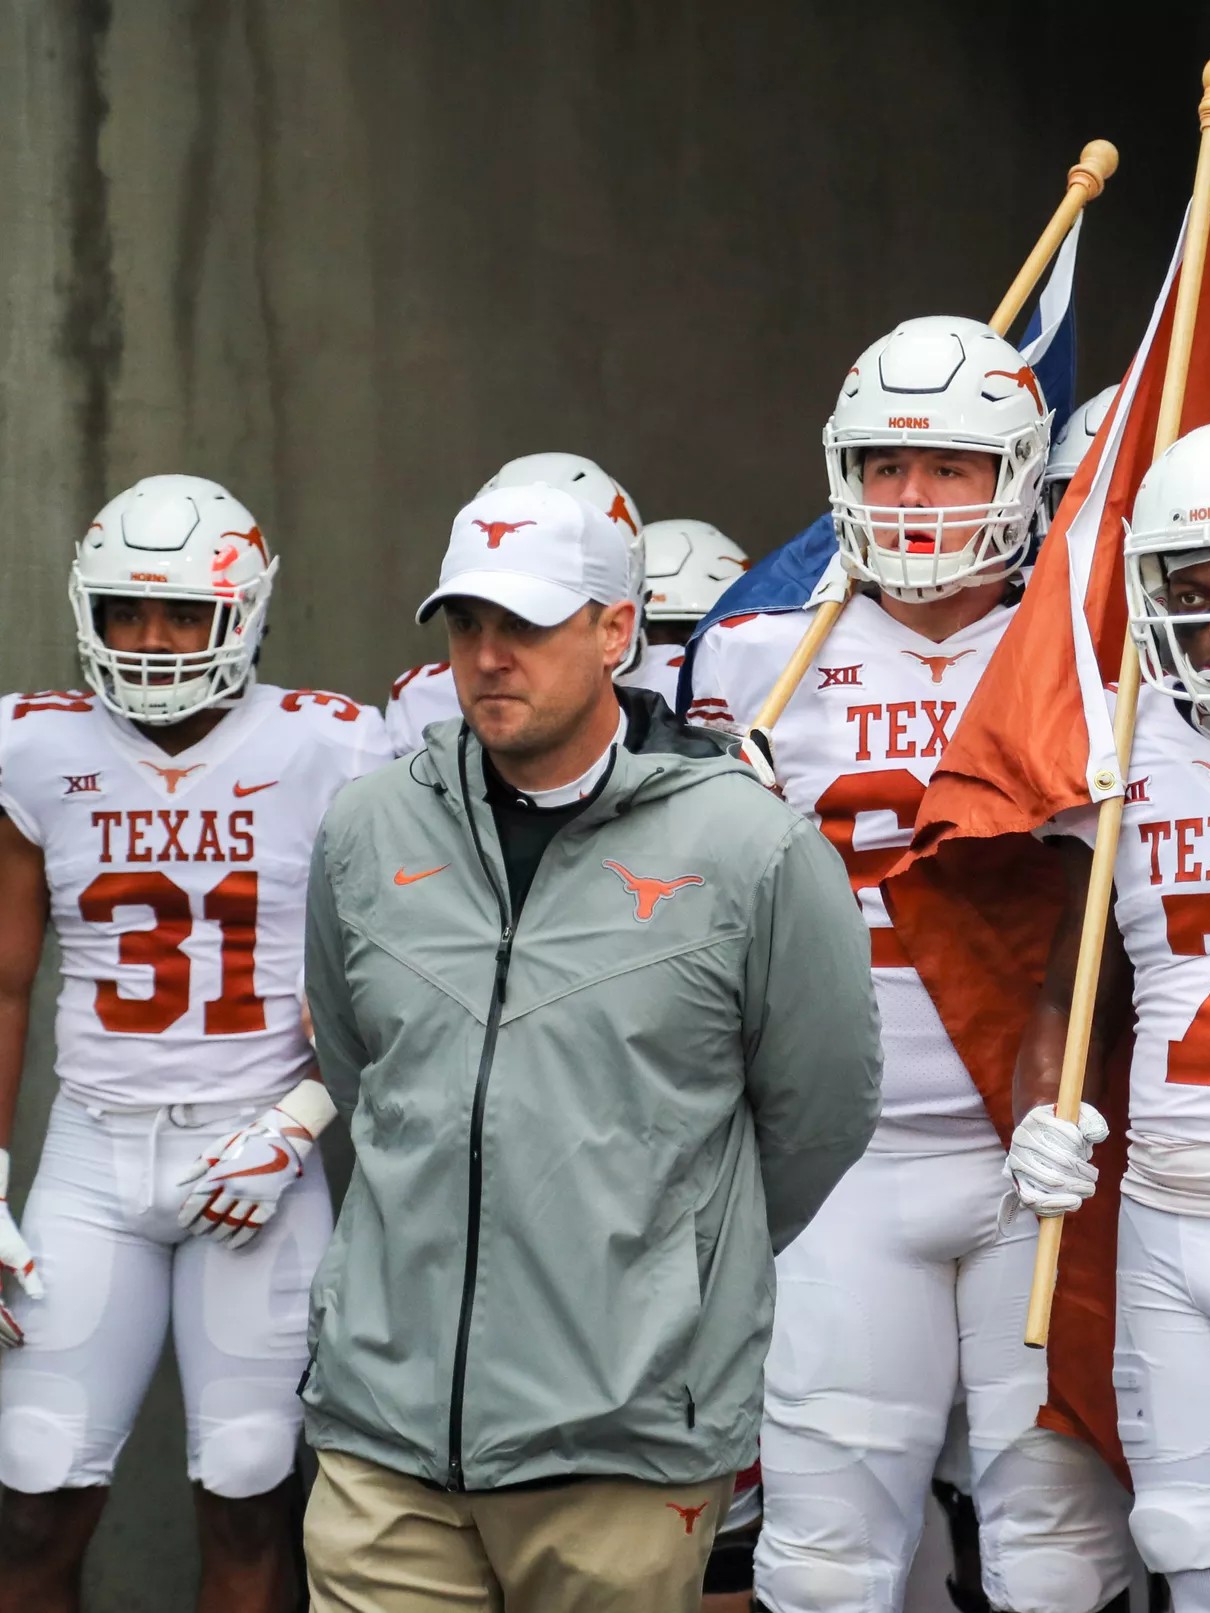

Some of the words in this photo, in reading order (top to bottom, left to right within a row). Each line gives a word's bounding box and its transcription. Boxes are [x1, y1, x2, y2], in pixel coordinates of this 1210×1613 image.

[888, 416, 930, 429] HORNS
[817, 664, 863, 690] XII
[846, 700, 957, 761] TEX
[62, 771, 102, 794] XII
[92, 810, 255, 864] TEXAS
[78, 870, 267, 1036] 31
